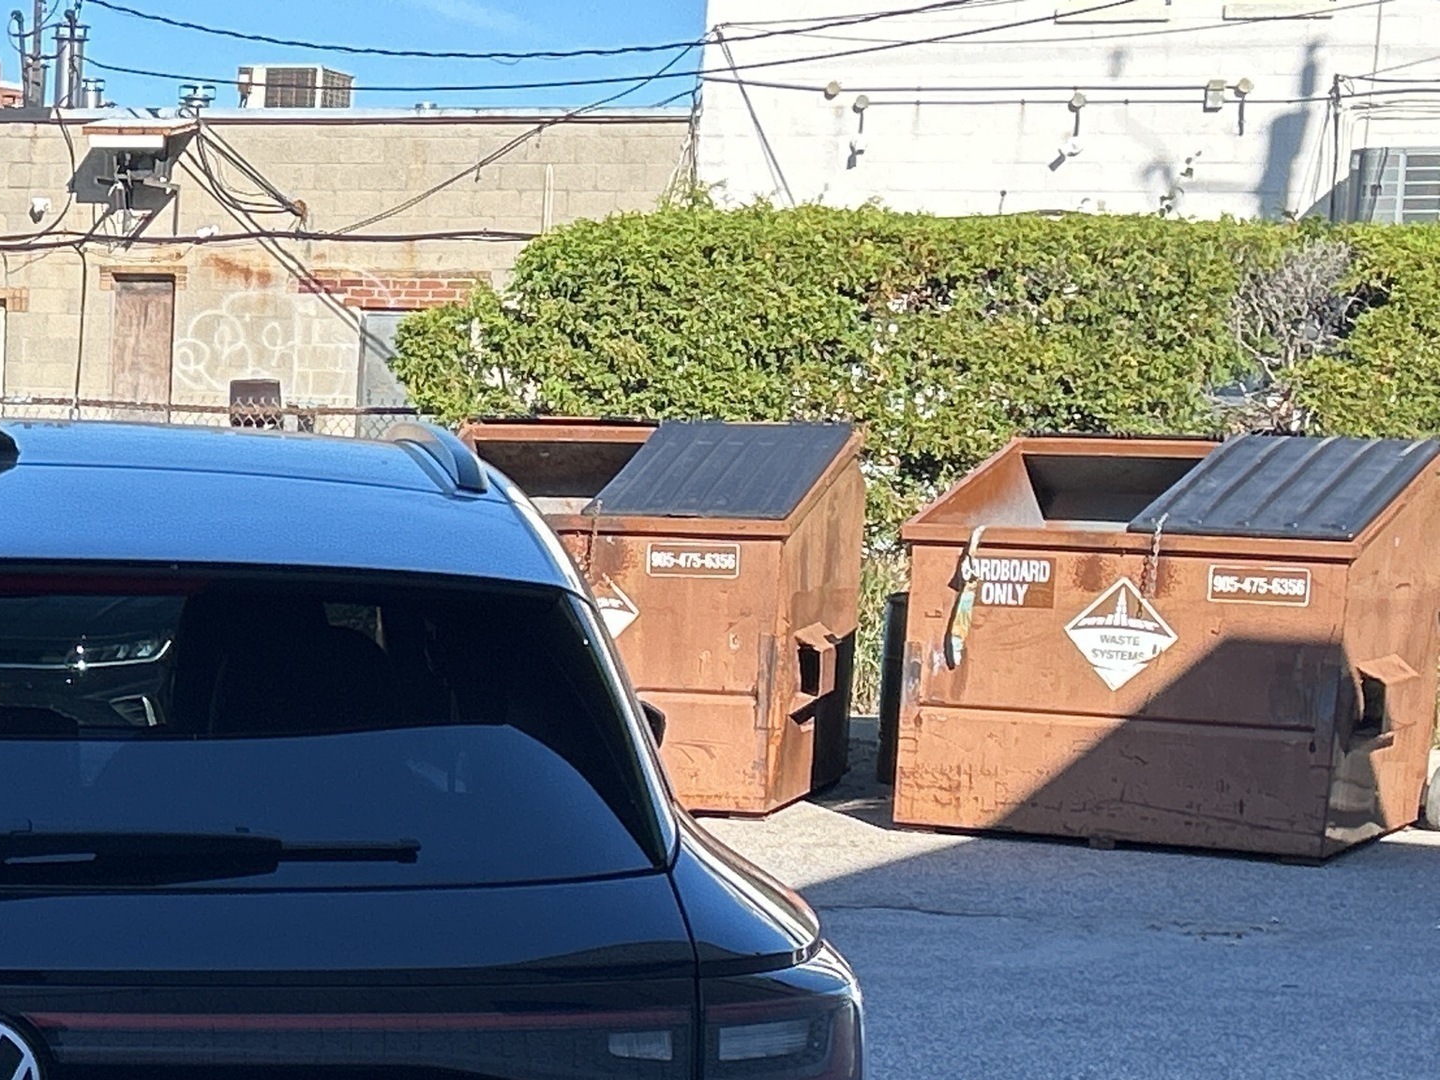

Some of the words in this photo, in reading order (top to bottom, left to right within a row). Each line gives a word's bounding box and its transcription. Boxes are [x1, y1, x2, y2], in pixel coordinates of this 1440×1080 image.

[652, 551, 736, 570] 905-475-6356
[981, 582, 1029, 606] ONLY
[1213, 574, 1306, 597] 905-475-6356
[1100, 634, 1140, 647] WASTE
